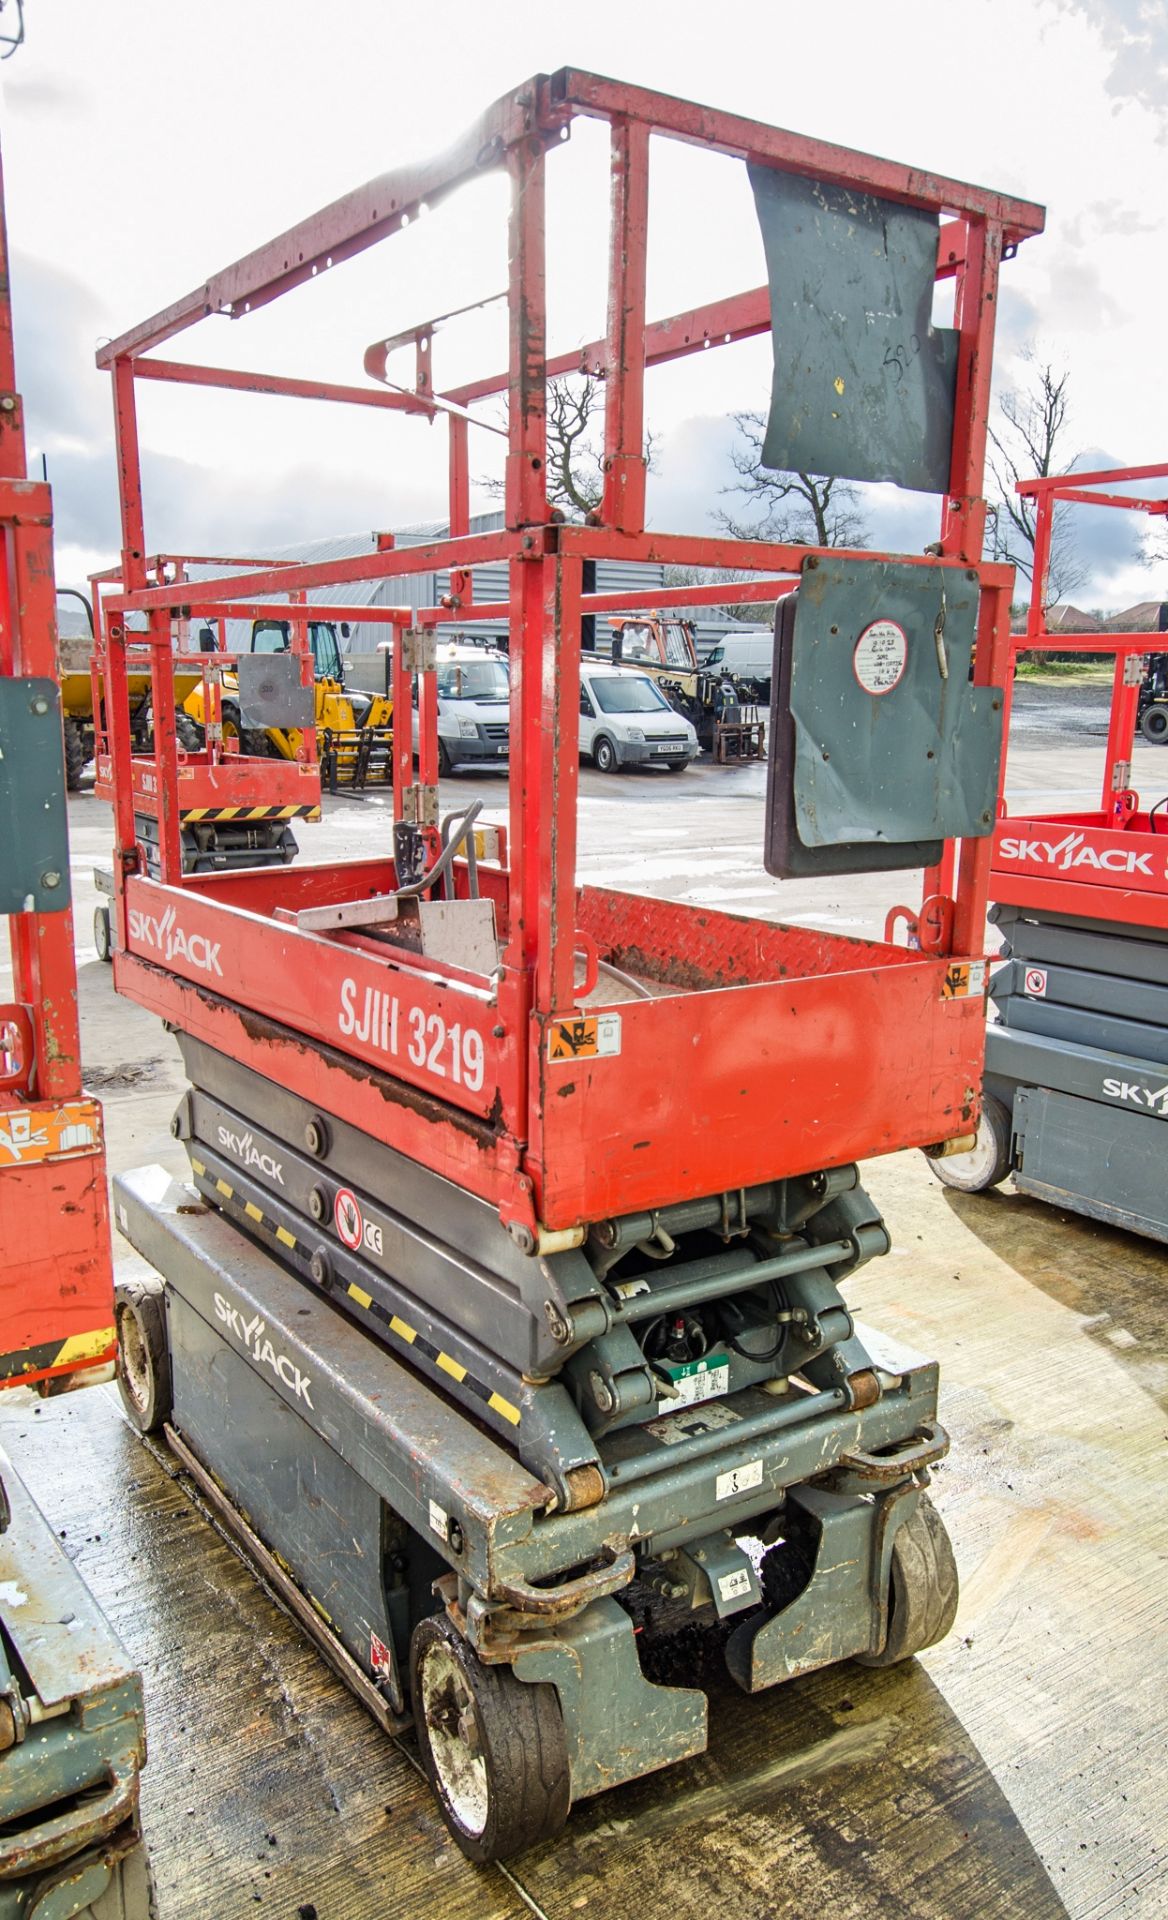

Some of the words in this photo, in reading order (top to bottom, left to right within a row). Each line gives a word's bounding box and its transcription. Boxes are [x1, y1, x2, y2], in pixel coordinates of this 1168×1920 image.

[999, 832, 1154, 875] SKYJACK
[128, 904, 223, 976] SKYJACK
[407, 1006, 485, 1092] 3219
[218, 1126, 285, 1186] SKYJACK
[214, 1292, 315, 1411] SKYJACK
